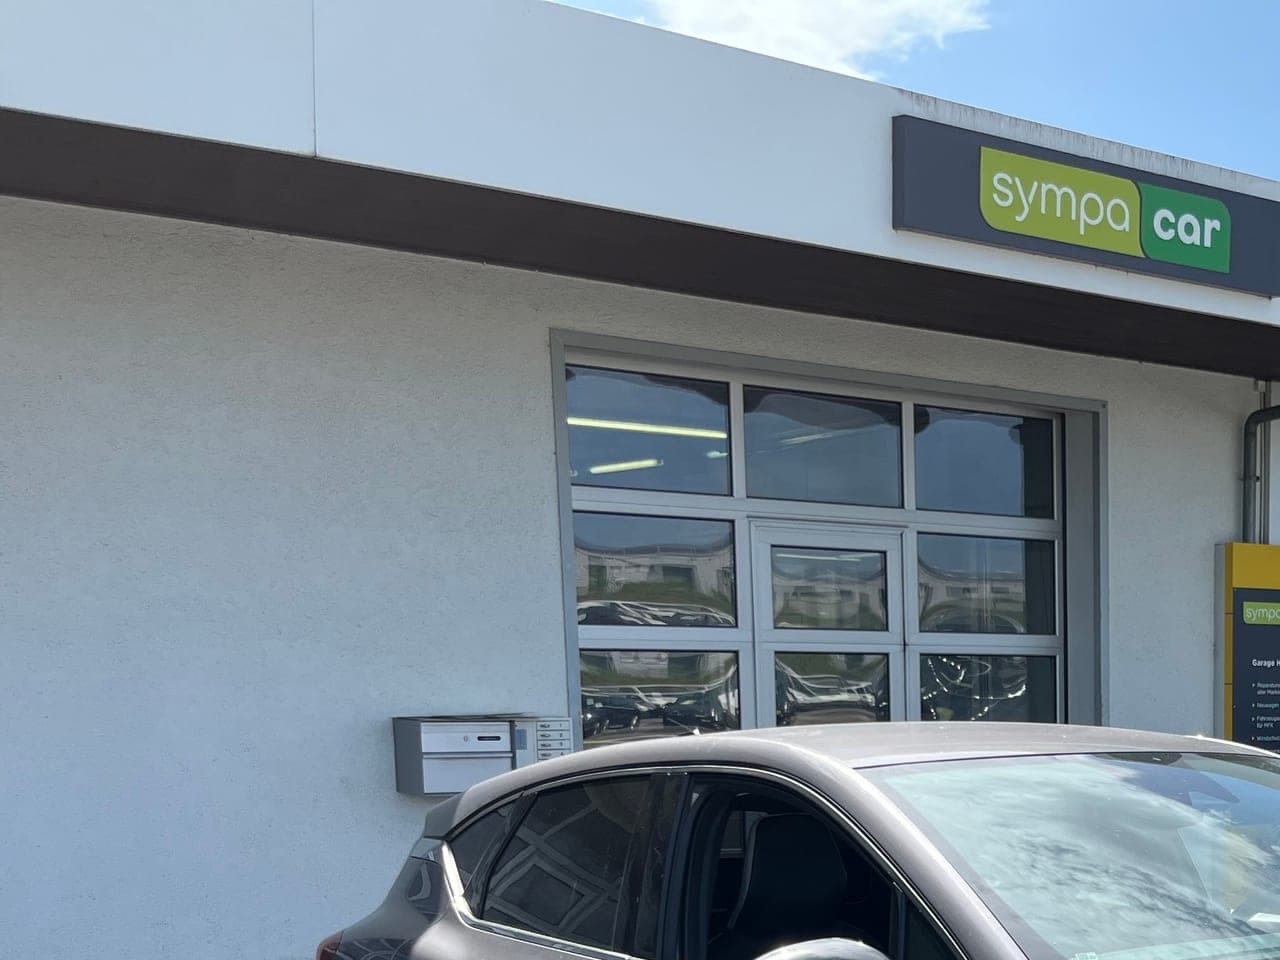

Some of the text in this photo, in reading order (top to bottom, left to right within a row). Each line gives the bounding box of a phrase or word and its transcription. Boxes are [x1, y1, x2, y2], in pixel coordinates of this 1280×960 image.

[992, 172, 1221, 248] sympa car
[1252, 659, 1275, 668] Garage
